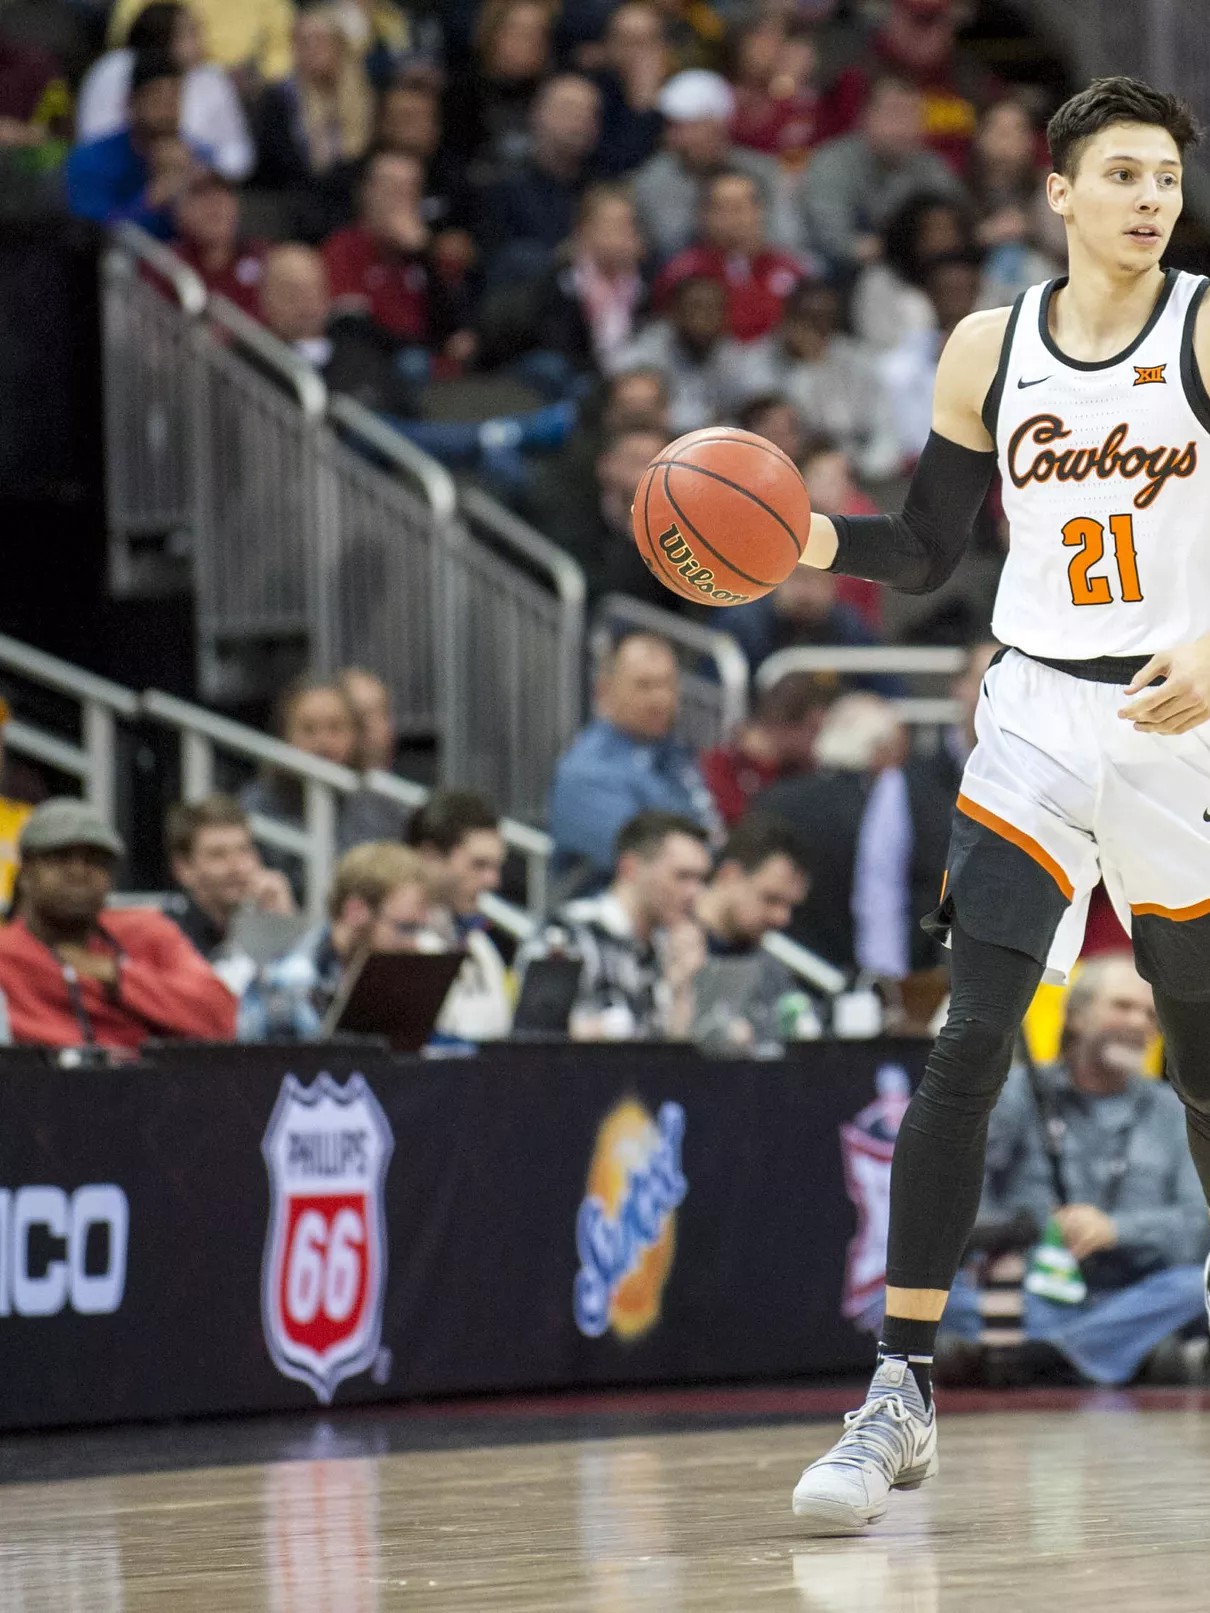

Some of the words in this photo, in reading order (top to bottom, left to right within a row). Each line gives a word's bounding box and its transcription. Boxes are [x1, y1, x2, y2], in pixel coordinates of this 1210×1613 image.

[1134, 364, 1167, 386] XII
[1007, 413, 1197, 509] Cowboys
[659, 522, 750, 602] Wilson
[1061, 514, 1144, 606] 21
[287, 1209, 363, 1324] 66
